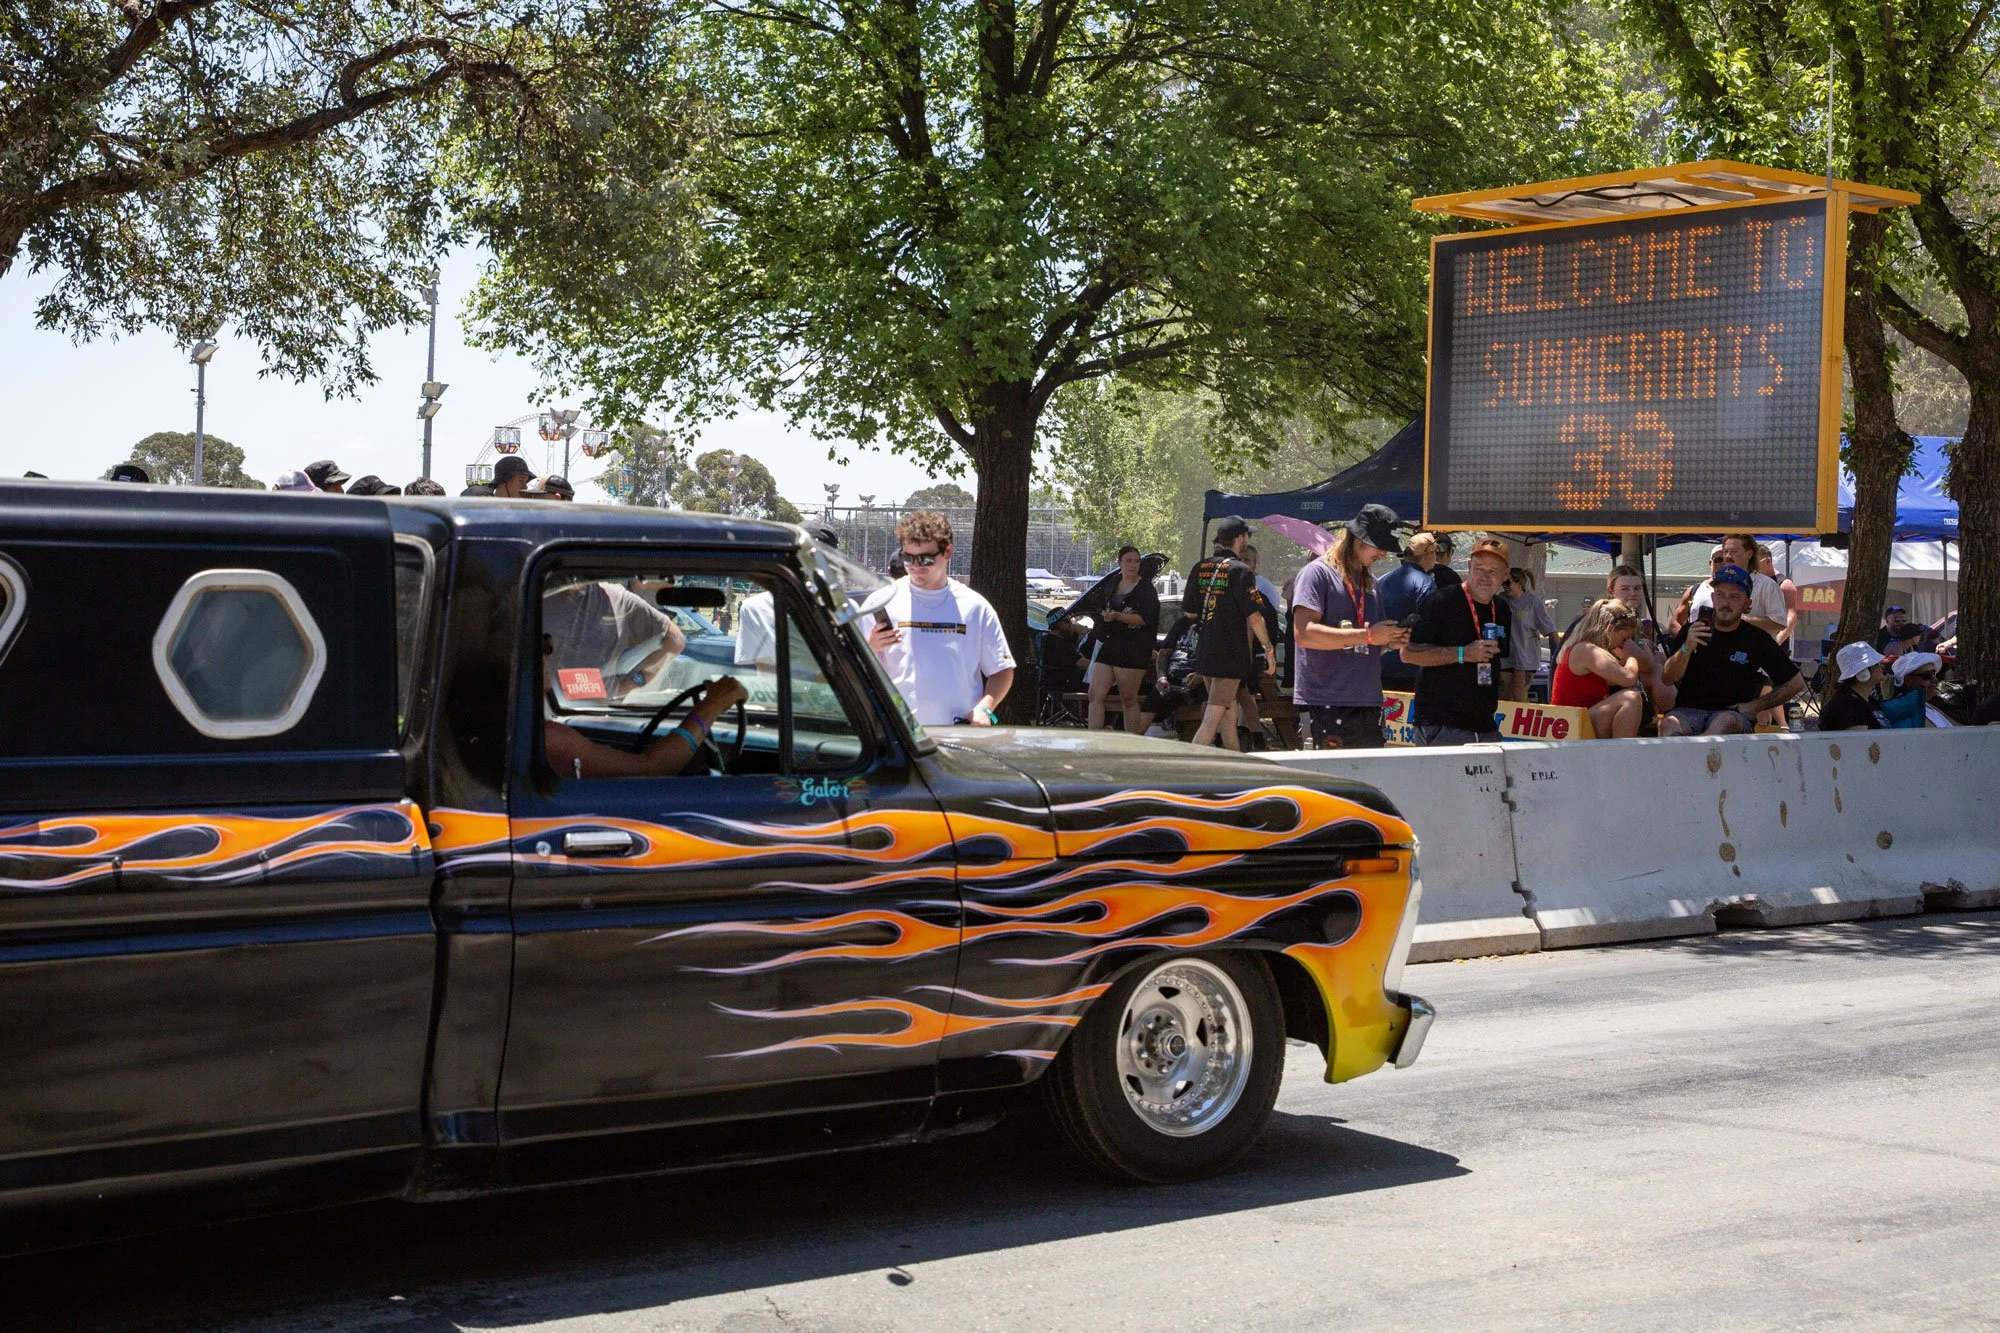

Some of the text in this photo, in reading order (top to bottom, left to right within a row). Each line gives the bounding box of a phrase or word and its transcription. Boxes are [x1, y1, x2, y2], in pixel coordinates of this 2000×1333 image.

[1467, 217, 1814, 316] WELCOME TO
[1484, 322, 1785, 407] SUMMERNATS
[1558, 411, 1674, 510] 38
[1803, 588, 1835, 603] BAR
[1511, 707, 1570, 740] Hire
[801, 777, 849, 805] Gator
